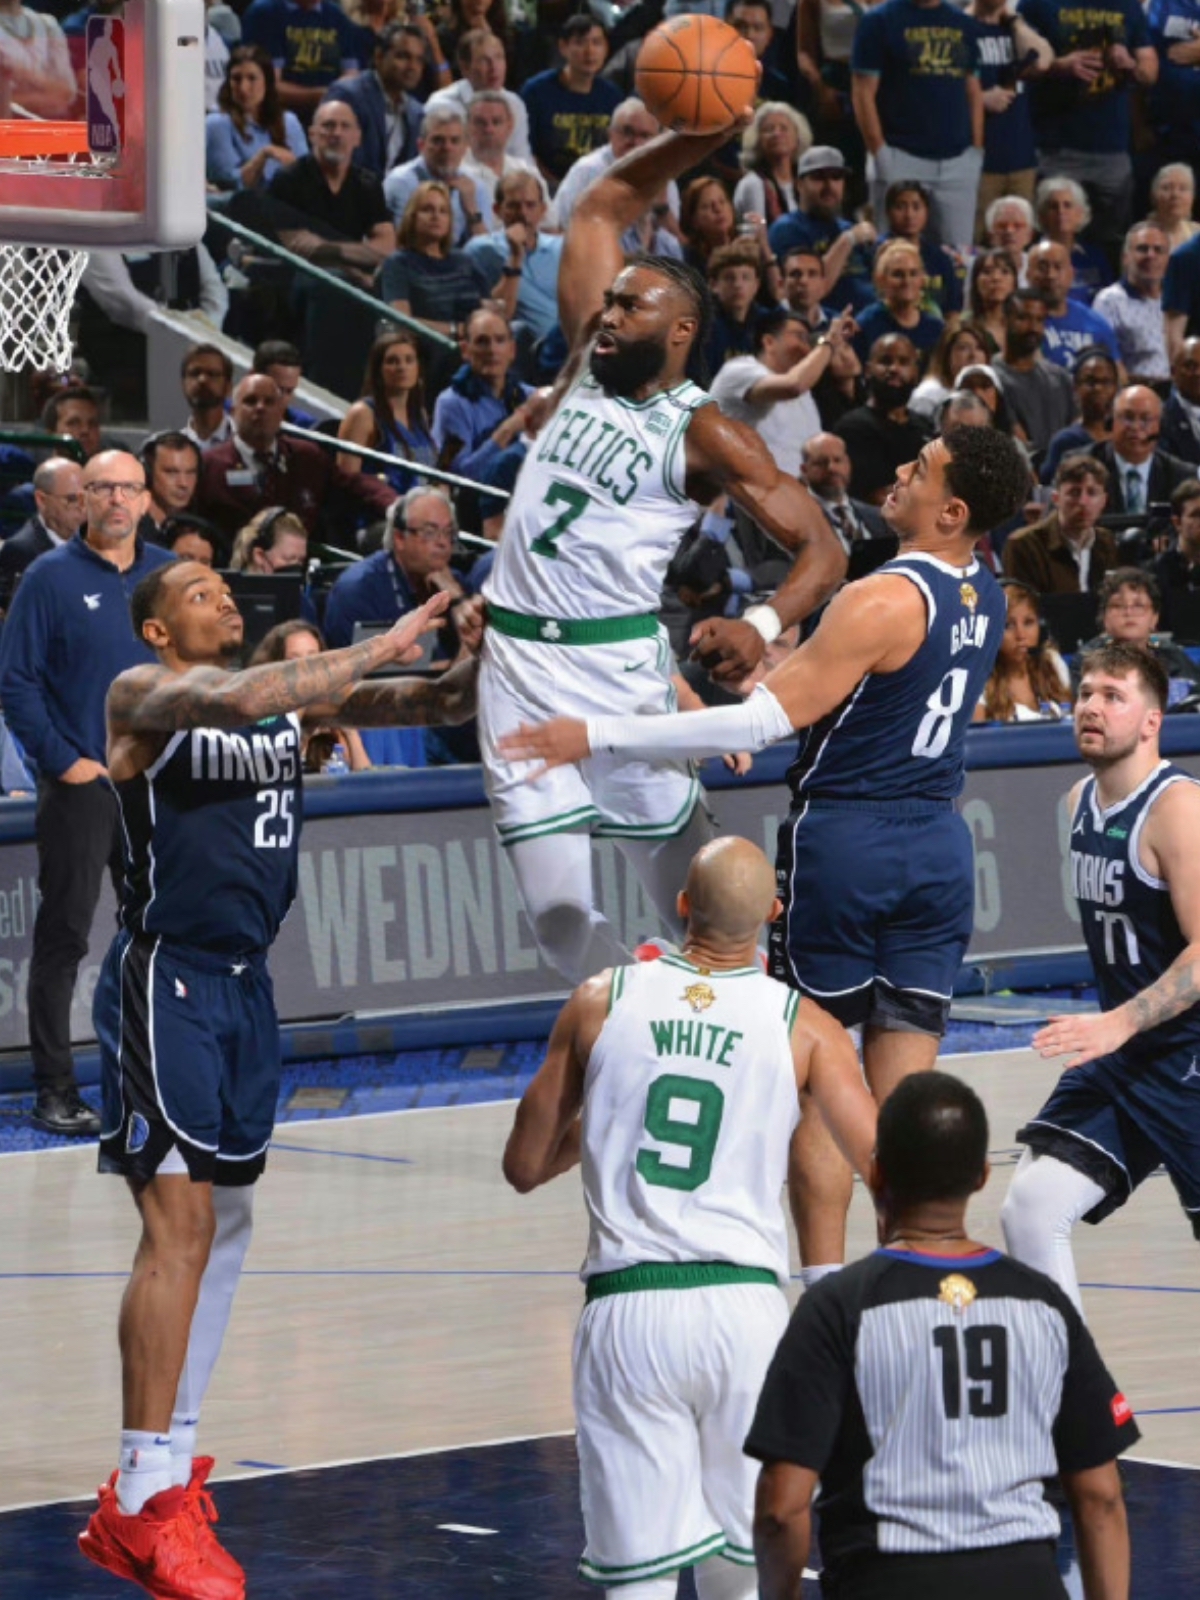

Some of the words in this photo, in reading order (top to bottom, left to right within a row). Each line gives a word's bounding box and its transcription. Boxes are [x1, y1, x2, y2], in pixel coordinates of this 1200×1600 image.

[91, 123, 113, 147] NBA
[537, 408, 653, 505] CELTICS
[530, 481, 591, 559] 7
[911, 667, 968, 759] 8
[254, 789, 295, 849] 25
[1095, 909, 1141, 965] 77
[649, 1018, 744, 1068] WHITE
[635, 1073, 725, 1192] 9
[932, 1323, 1008, 1419] 19
